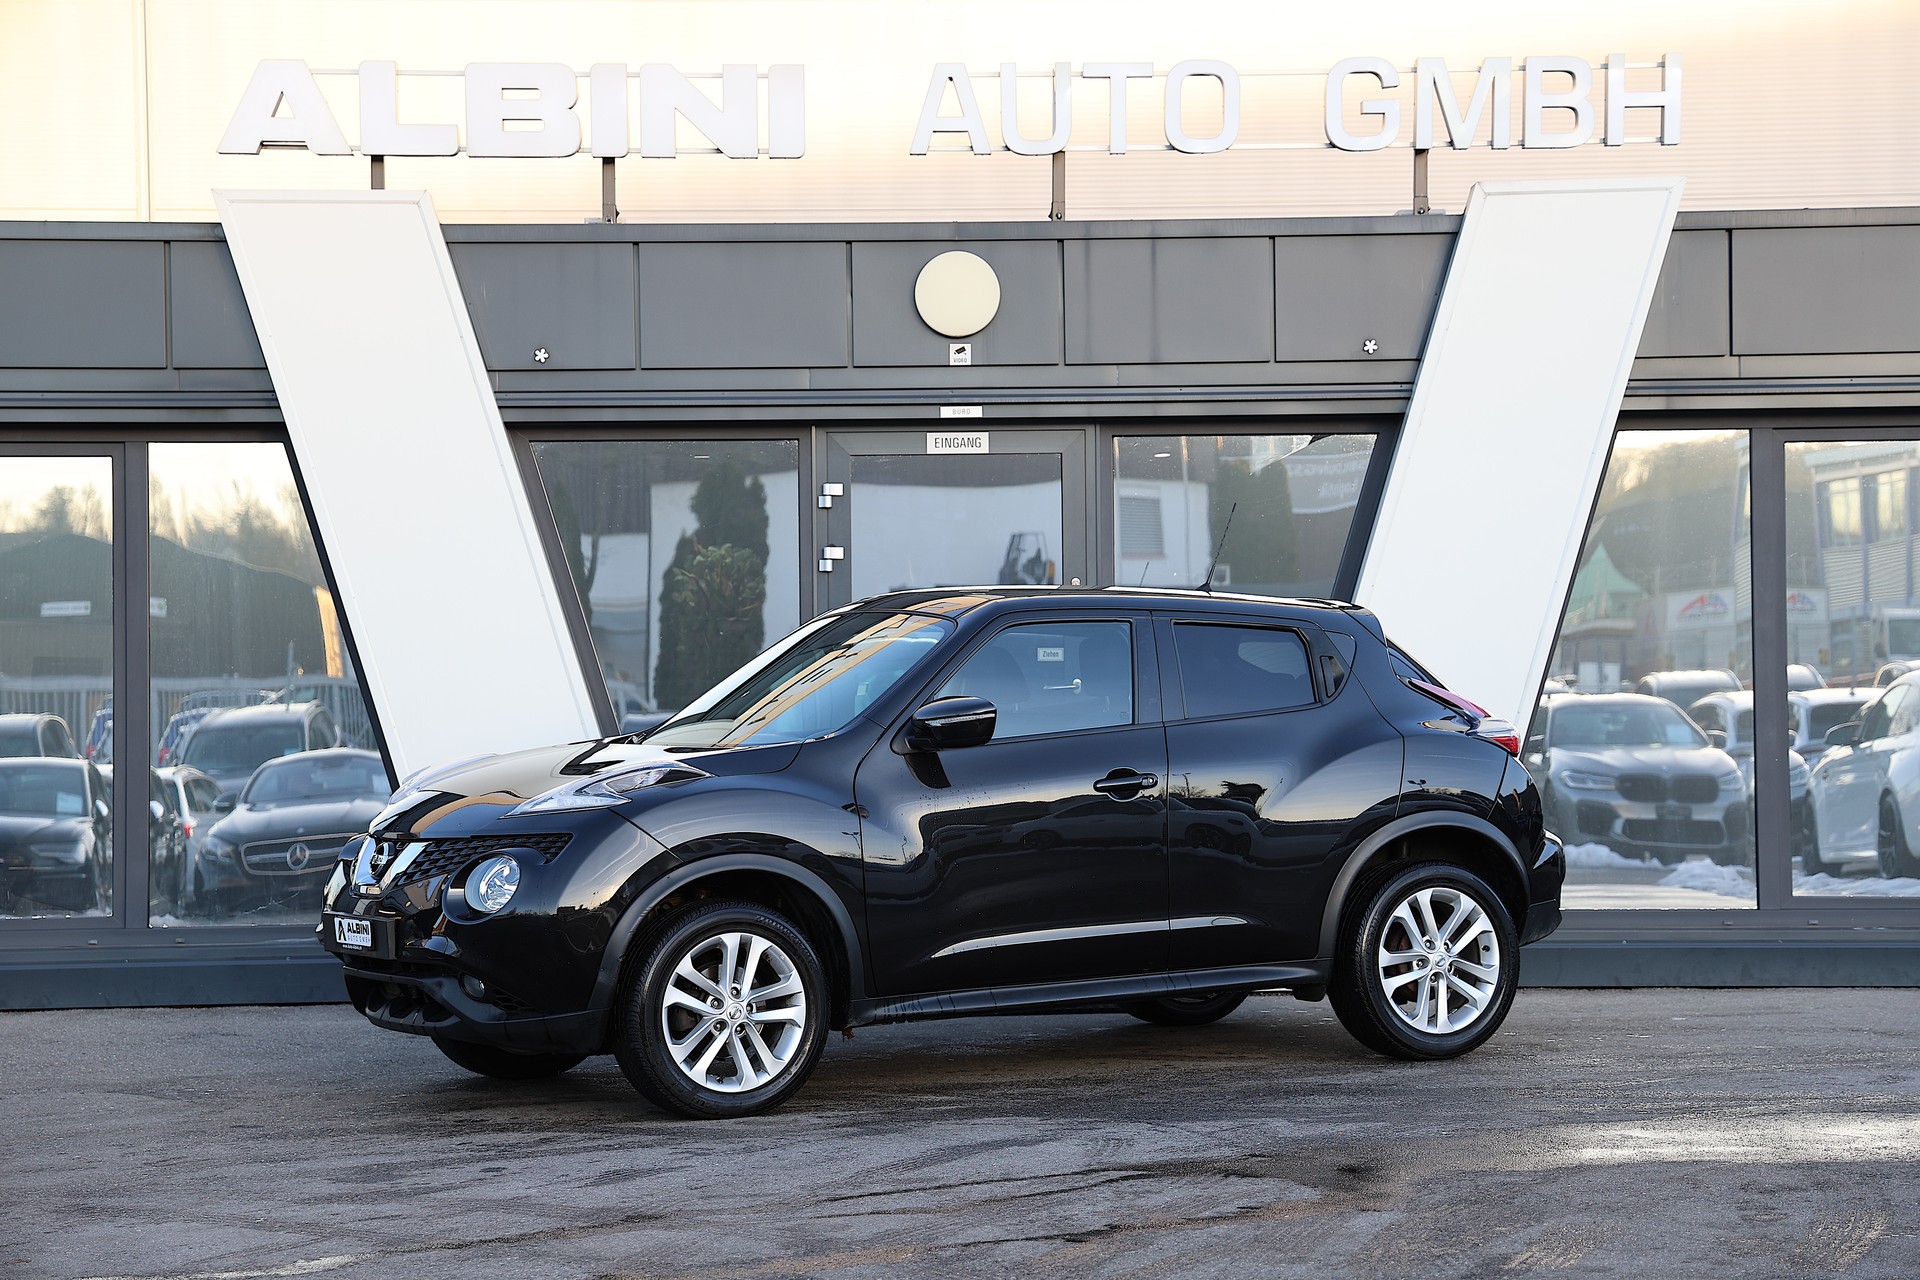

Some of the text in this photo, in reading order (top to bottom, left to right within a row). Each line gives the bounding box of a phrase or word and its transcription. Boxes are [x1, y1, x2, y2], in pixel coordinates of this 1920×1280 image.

[216, 52, 1684, 159] ALBINI AUTO GMBH
[934, 437, 982, 449] EINGANG
[1042, 650, 1060, 658] Ziehen
[347, 921, 370, 936] ALBINI
